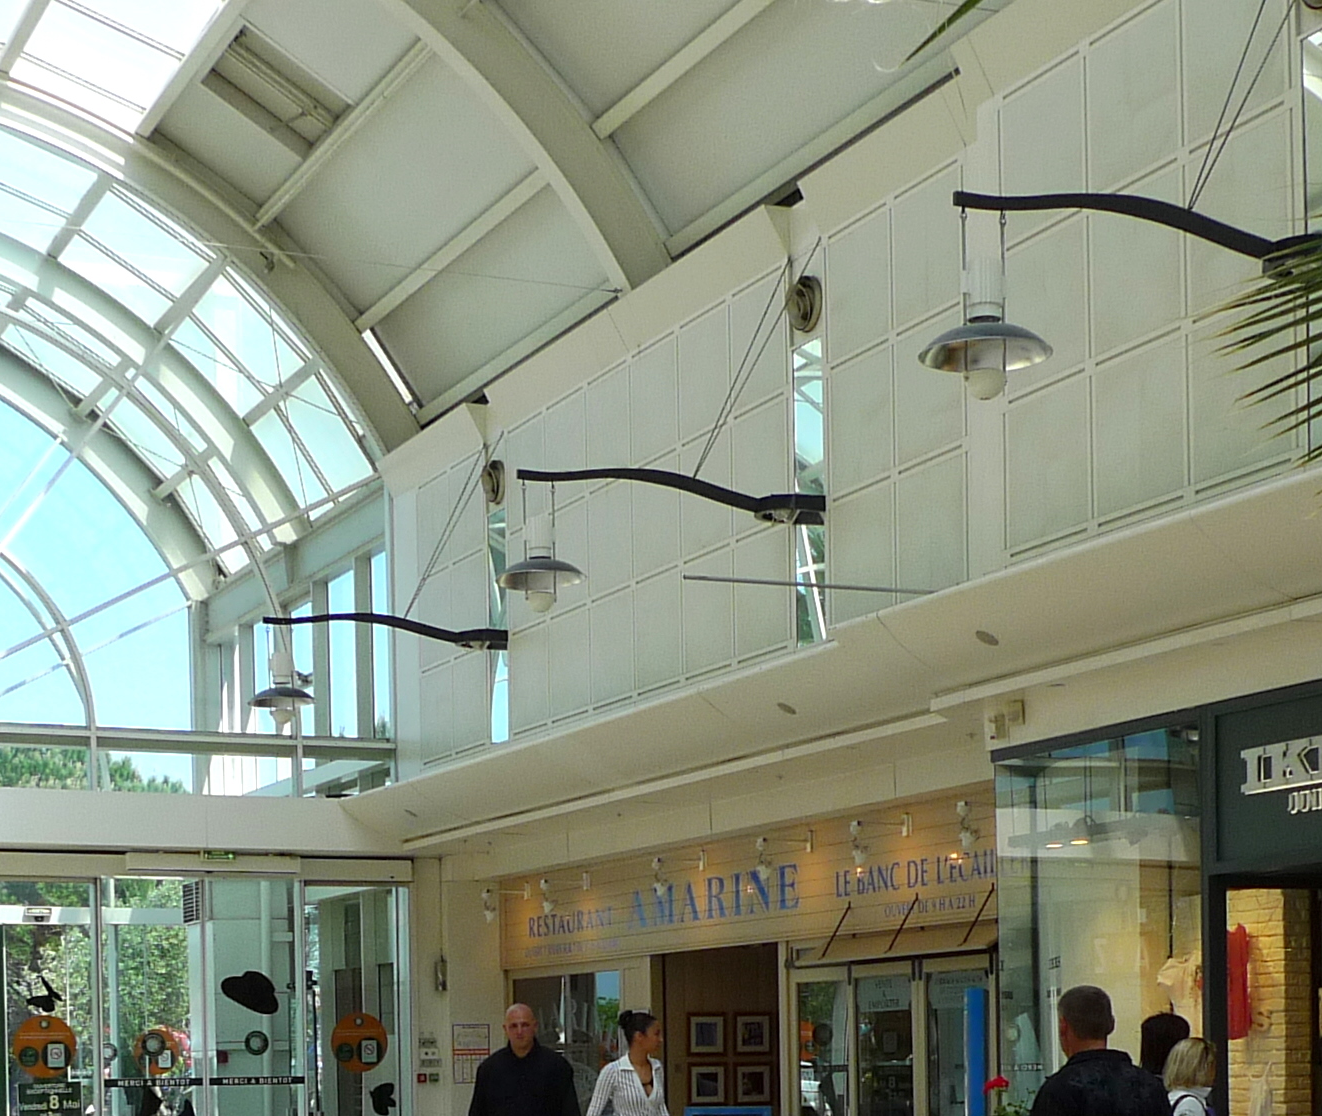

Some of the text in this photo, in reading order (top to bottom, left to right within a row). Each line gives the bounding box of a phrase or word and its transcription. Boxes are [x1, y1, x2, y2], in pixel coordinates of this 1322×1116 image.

[835, 869, 851, 898] LE
[856, 860, 901, 896] BANC
[906, 855, 928, 889] DE
[528, 863, 801, 939] RESTAURANT AMARINE
[117, 1079, 144, 1087] MERCI
[156, 1078, 191, 1087] BIENTOT
[222, 1077, 248, 1085] MERCI
[259, 1076, 293, 1085] BIENTOT
[49, 1094, 60, 1110] 8
[63, 1099, 81, 1110] Mai
